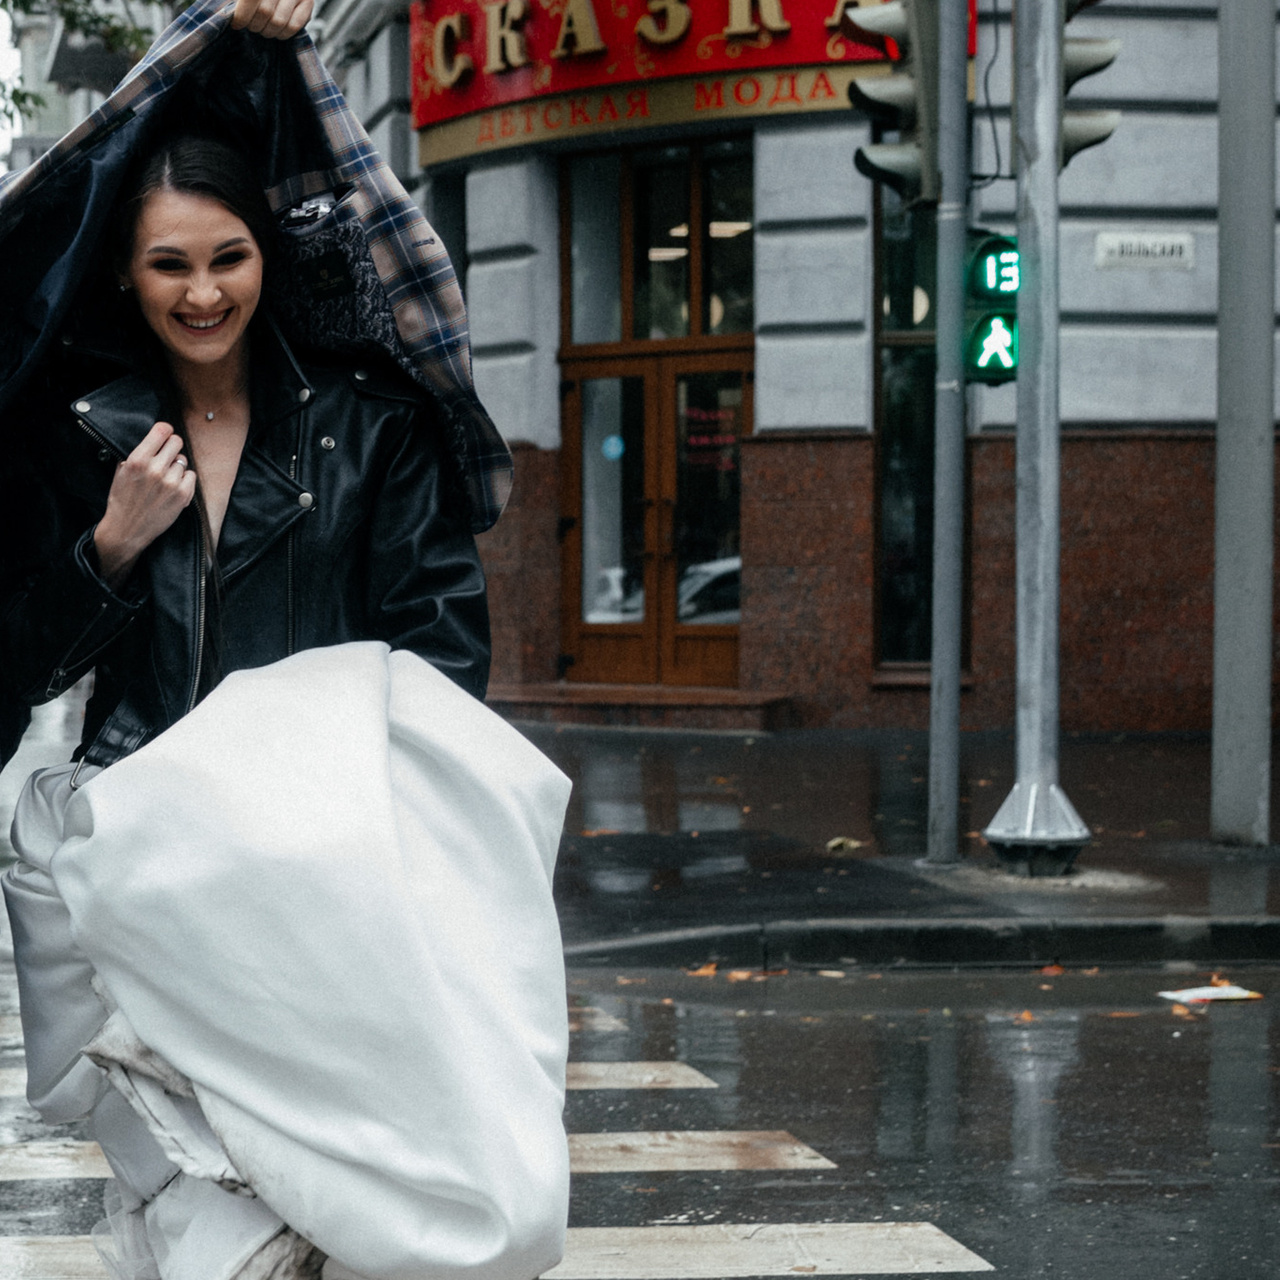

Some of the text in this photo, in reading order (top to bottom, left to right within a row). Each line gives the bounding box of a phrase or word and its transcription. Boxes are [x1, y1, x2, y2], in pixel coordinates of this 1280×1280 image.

[477, 72, 837, 146] ДЕТСКАЯ МОДА
[986, 252, 1020, 291] 13
